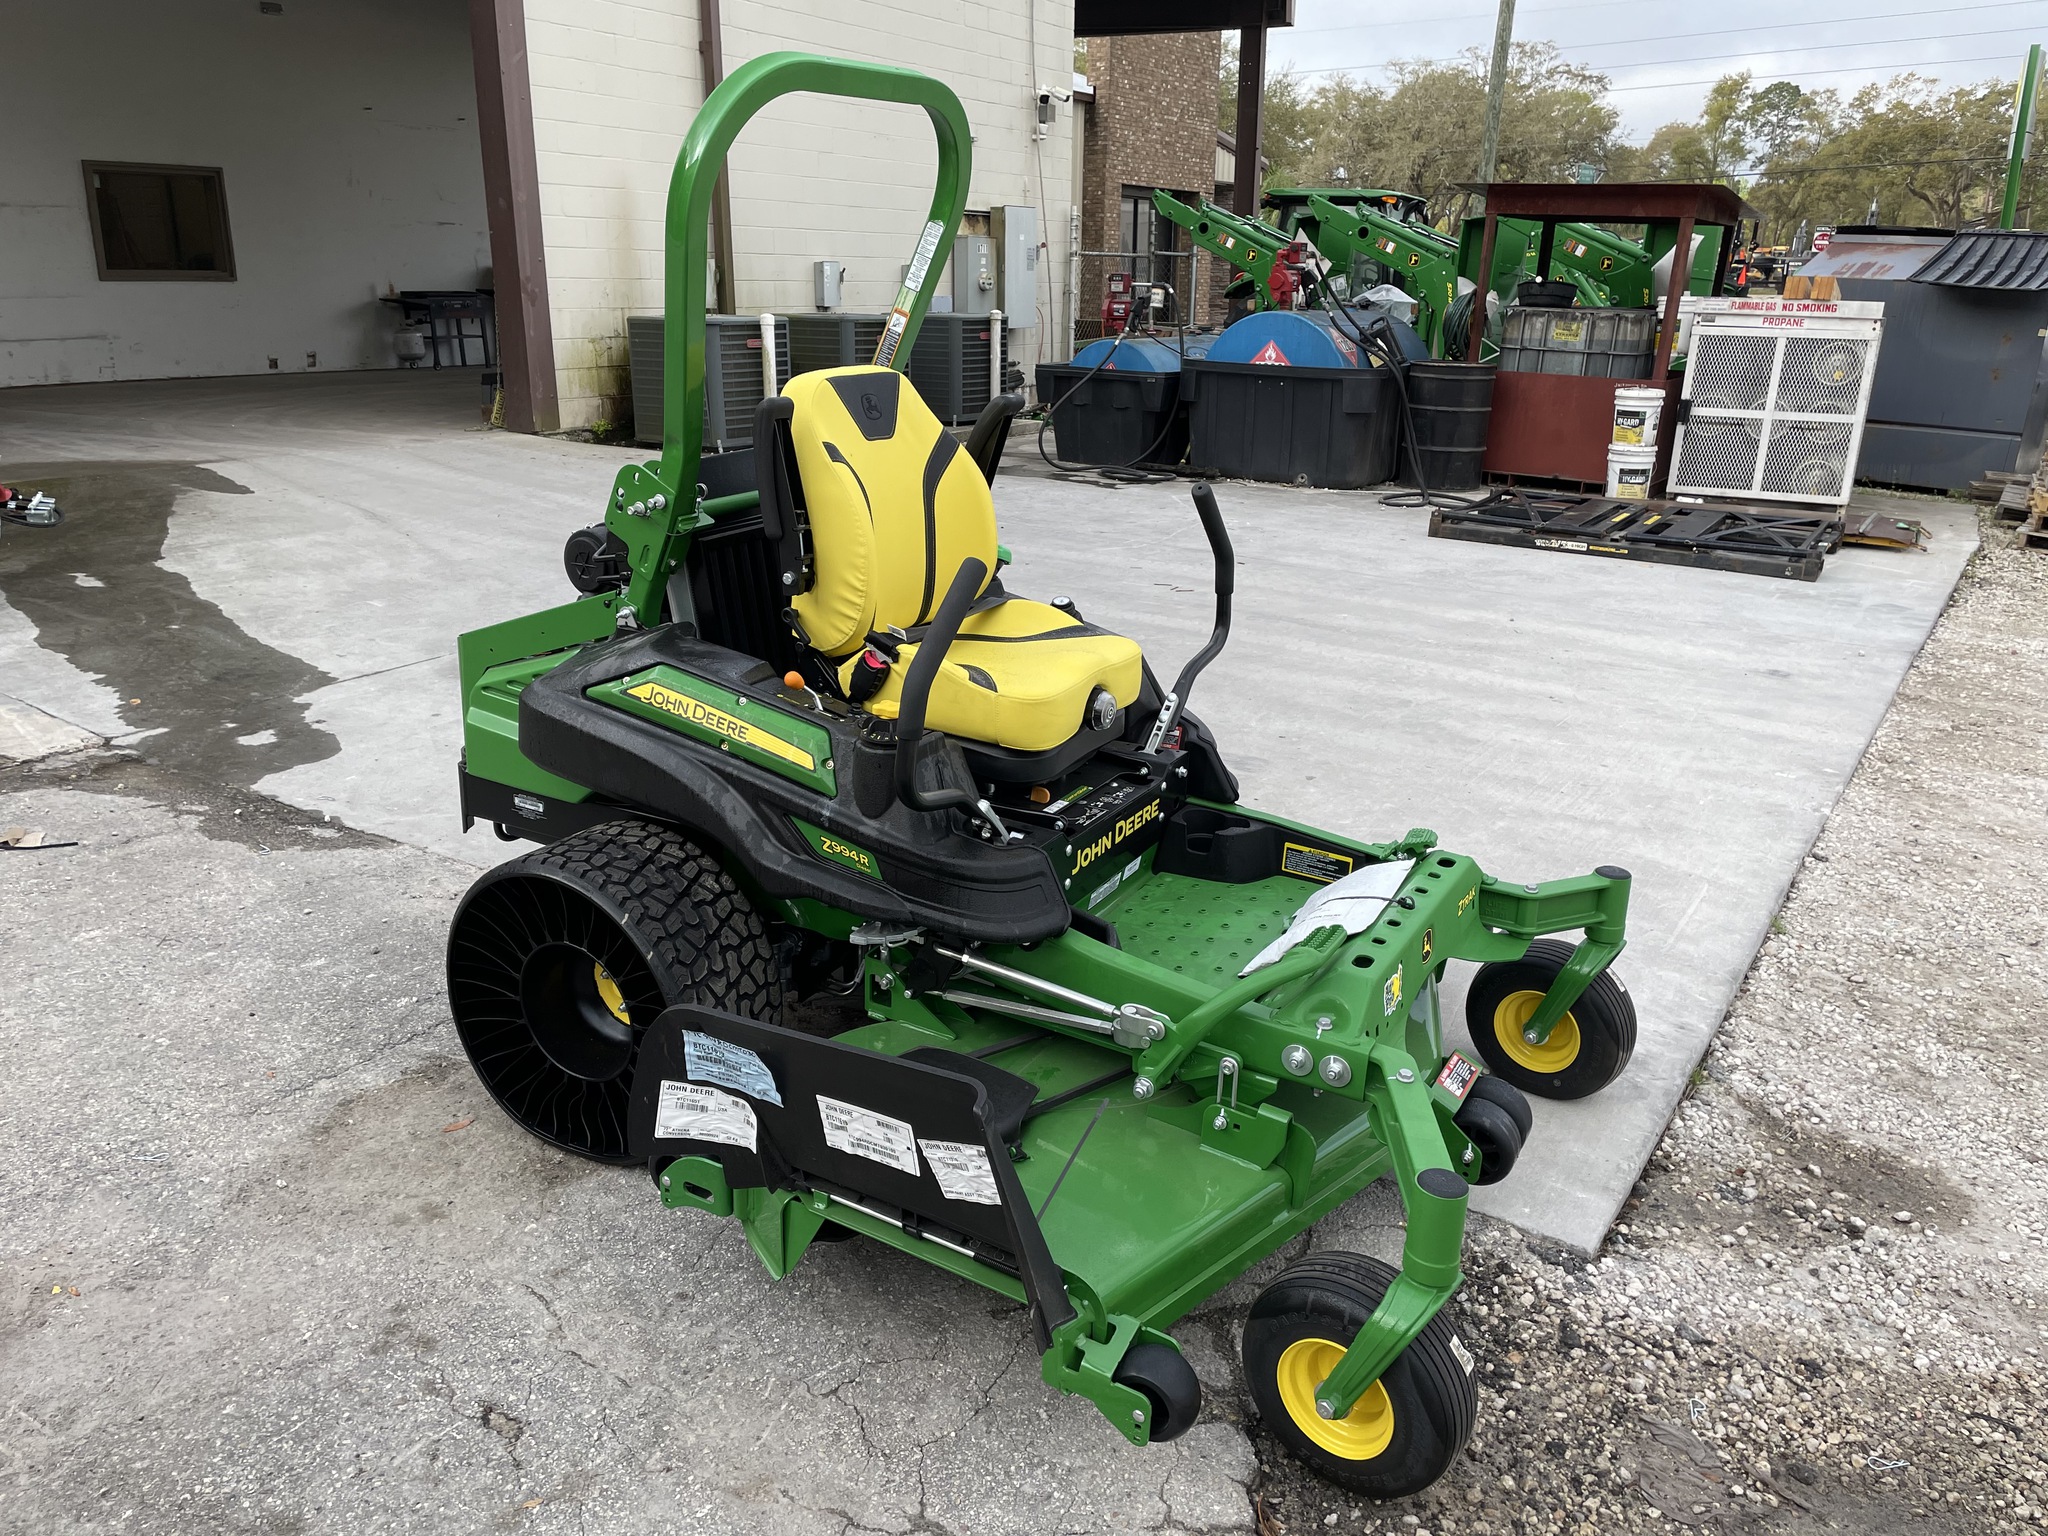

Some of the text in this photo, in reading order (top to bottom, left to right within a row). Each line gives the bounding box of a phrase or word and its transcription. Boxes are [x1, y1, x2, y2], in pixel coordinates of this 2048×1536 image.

[1731, 301, 1765, 311] FLAMMABLE
[1765, 302, 1777, 311] GAS
[1781, 303, 1794, 312] NO
[1796, 303, 1838, 313] SMOKING
[1762, 316, 1805, 328] PROPANE
[643, 686, 750, 741] JOHN DEERE
[1071, 831, 1113, 876] JOHN
[1114, 798, 1160, 845] DEERE
[820, 836, 869, 867] Z994R
[1457, 884, 1476, 918] ZTRAK
[666, 1083, 715, 1097] JOHN DEERE
[825, 1104, 854, 1119] JOHN DEERE
[924, 1142, 963, 1154] JOHN DEERE
